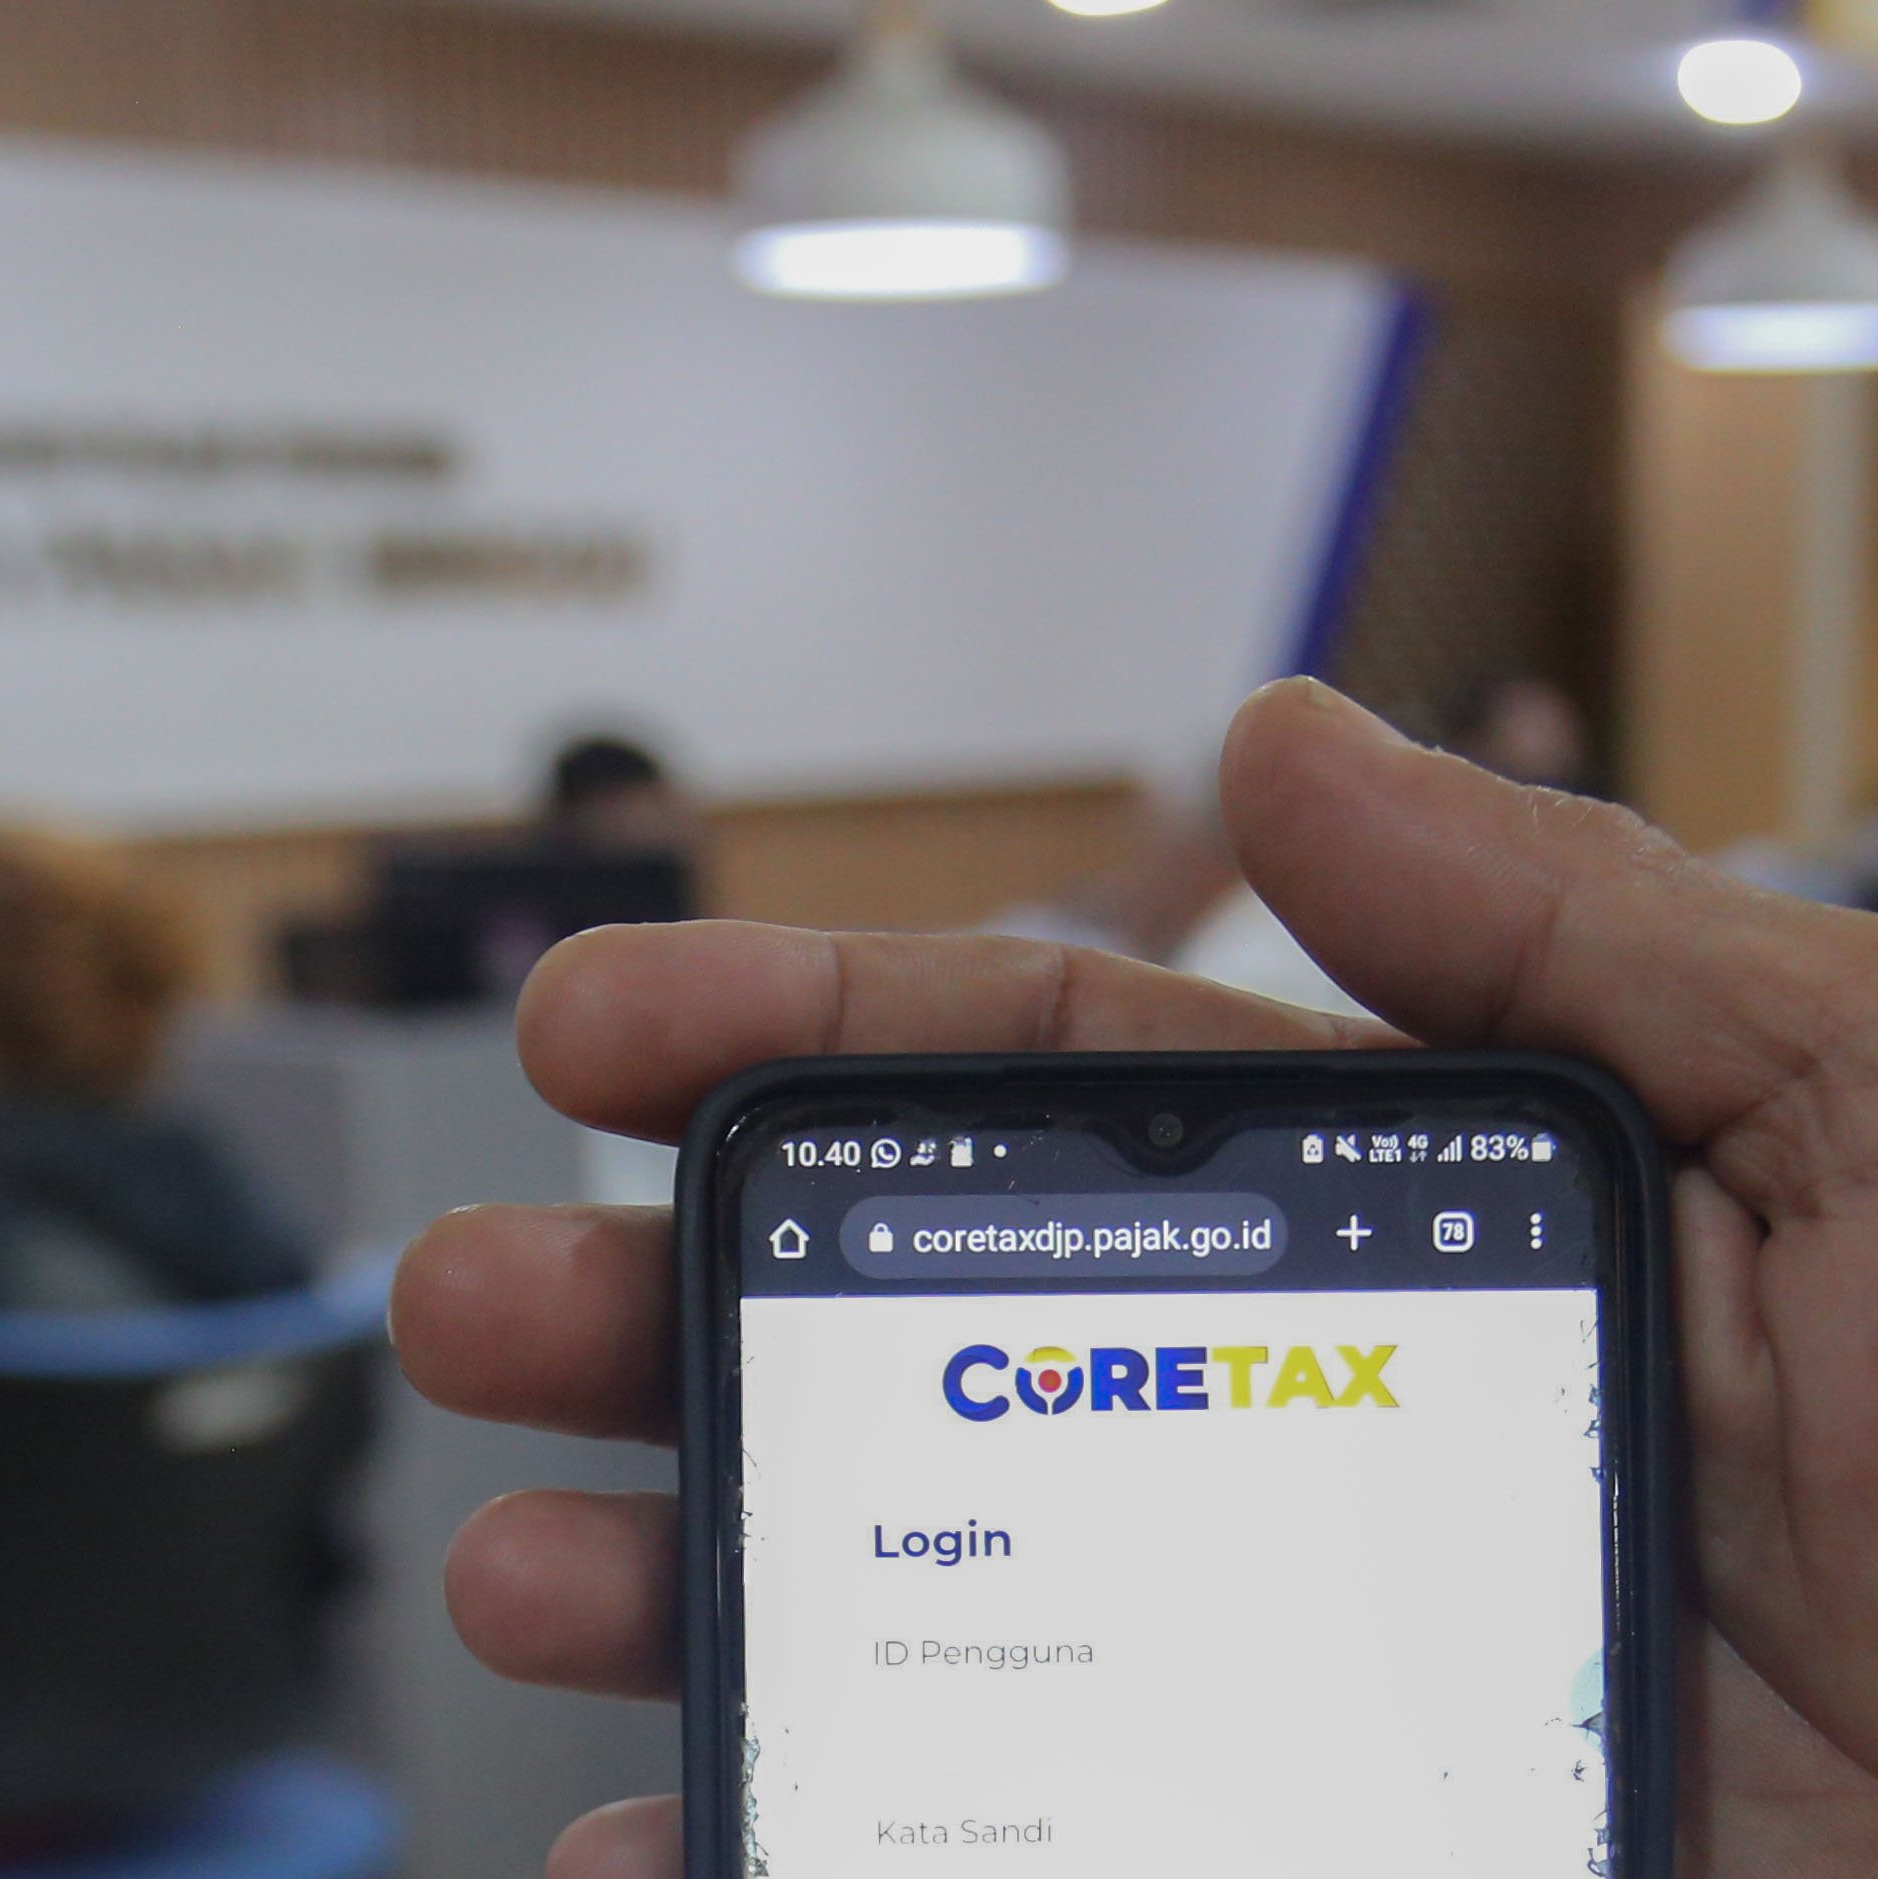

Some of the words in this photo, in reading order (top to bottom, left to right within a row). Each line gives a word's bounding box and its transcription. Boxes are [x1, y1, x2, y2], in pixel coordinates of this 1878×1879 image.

[781, 1140, 862, 1168] 10.40
[1407, 1134, 1428, 1149] 4G
[1470, 1134, 1528, 1161] 83%
[913, 1219, 1271, 1259] coretaxdjp.pajak.go.id
[1442, 1222, 1465, 1241] 78
[942, 1344, 1399, 1422] CORETAX
[874, 1518, 1012, 1567] Login
[875, 1641, 909, 1666] ID
[921, 1640, 1094, 1670] Pengguna
[877, 1821, 948, 1846] Kata
[960, 1817, 1052, 1844] Sandi
